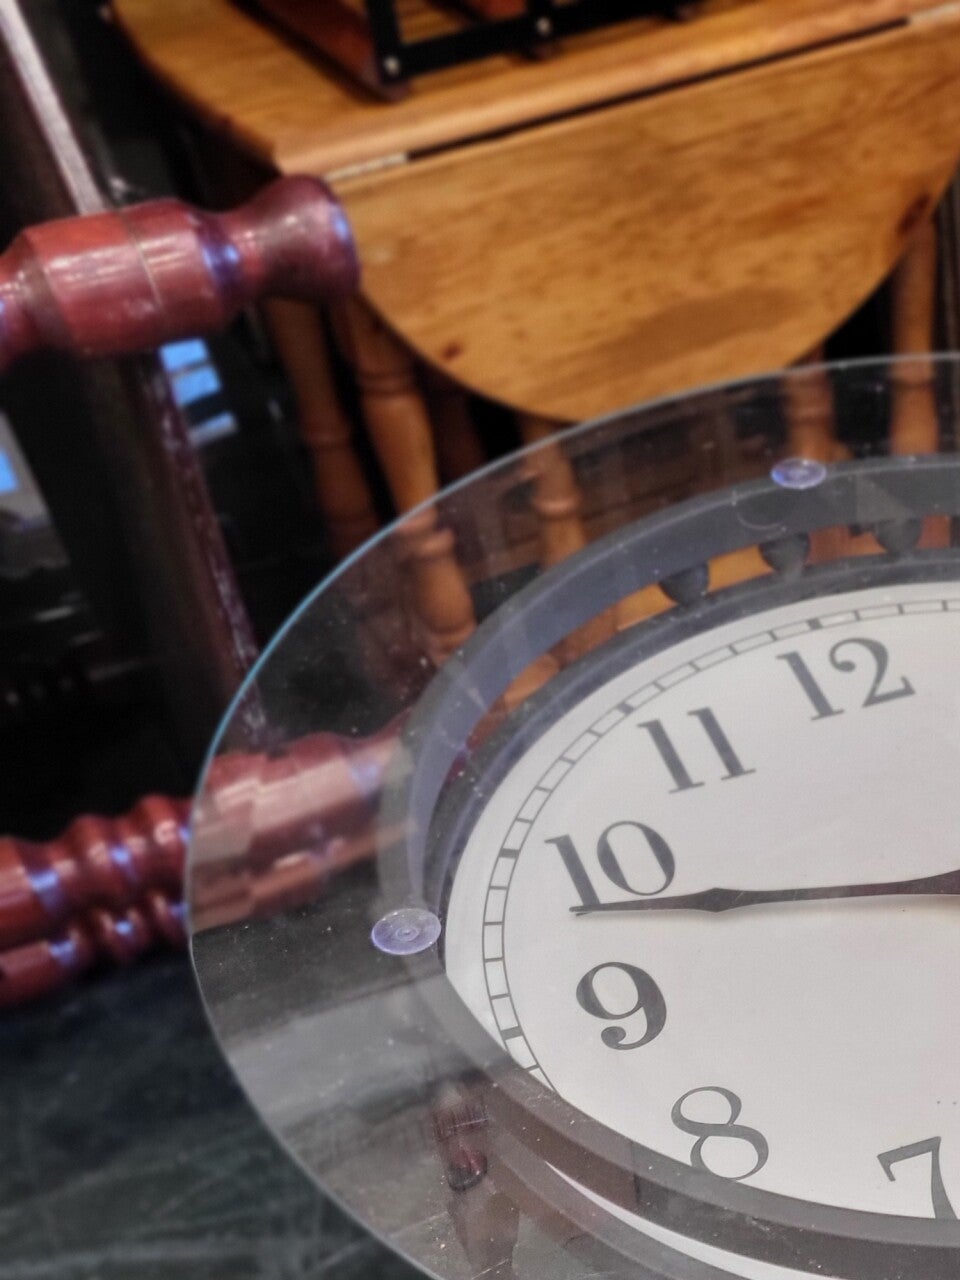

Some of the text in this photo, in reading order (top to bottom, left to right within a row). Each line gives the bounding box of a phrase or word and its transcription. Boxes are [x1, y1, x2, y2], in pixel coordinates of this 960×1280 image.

[776, 636, 916, 721] 12
[638, 706, 757, 794] 11
[544, 820, 676, 915] 10
[575, 961, 667, 1050] 9
[671, 1086, 769, 1181] 8
[877, 1136, 958, 1220] 7
